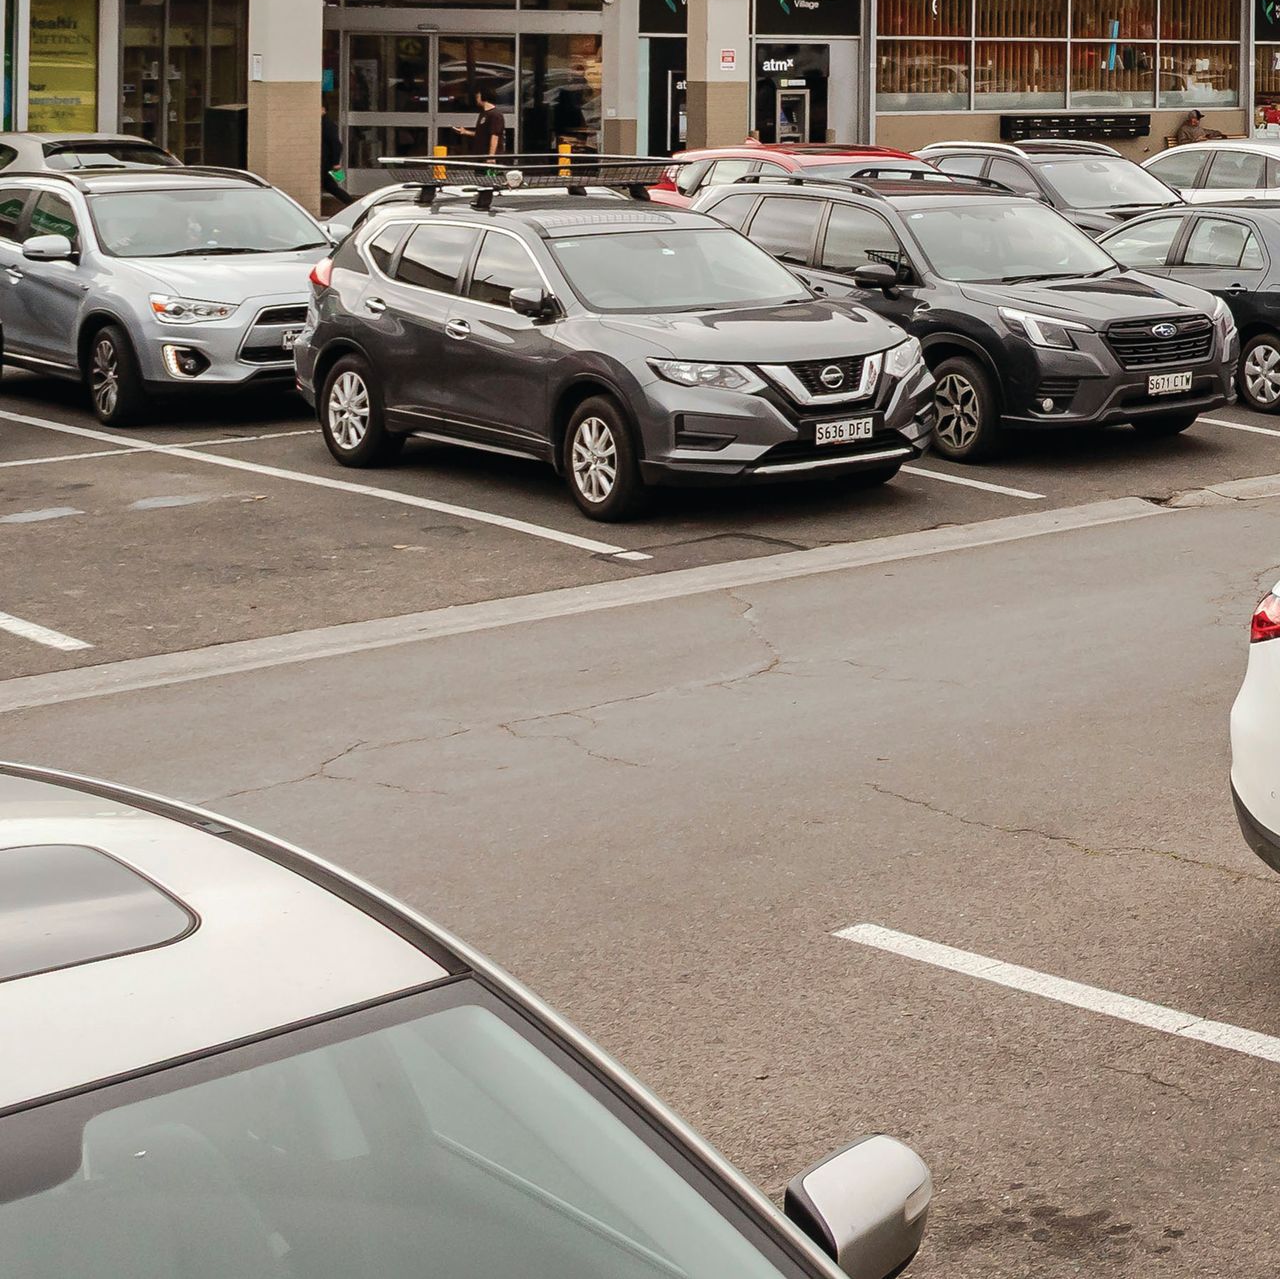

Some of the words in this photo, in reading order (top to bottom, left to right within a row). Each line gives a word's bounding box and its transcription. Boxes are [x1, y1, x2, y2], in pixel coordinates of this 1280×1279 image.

[793, 0, 819, 10] Village
[1149, 377, 1170, 390] S671
[1173, 374, 1191, 387] CTW
[817, 425, 844, 440] S636
[848, 421, 870, 436] DFG
